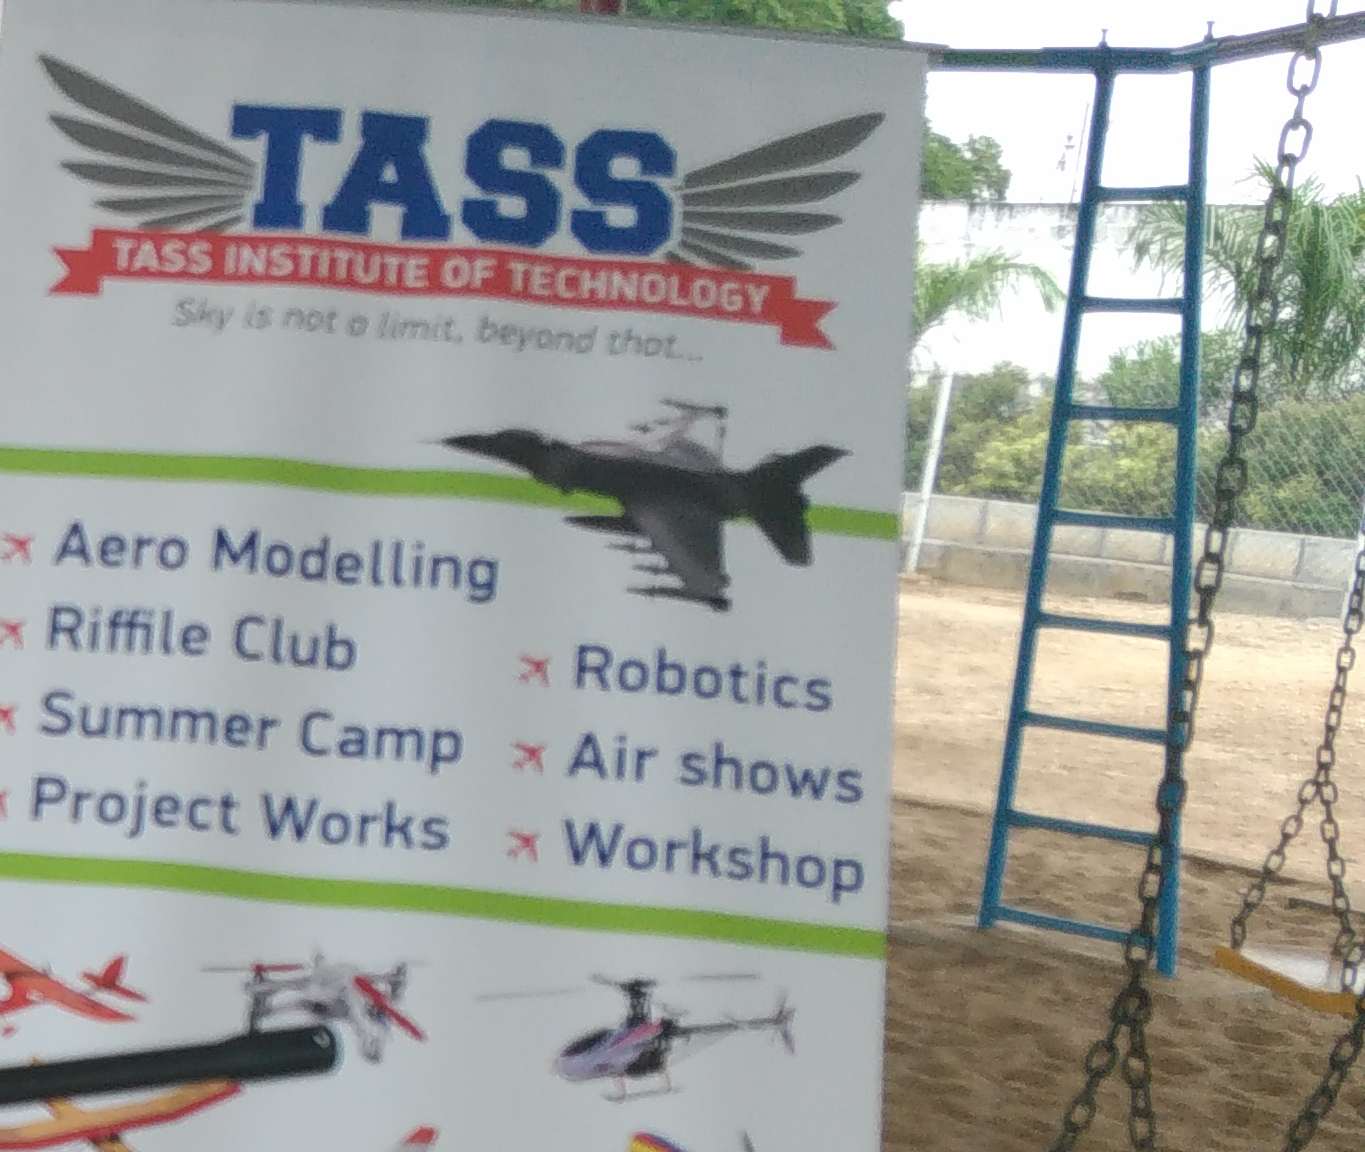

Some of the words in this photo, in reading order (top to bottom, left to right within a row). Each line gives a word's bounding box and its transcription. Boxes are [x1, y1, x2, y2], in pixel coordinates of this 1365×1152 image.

[231, 104, 678, 257] TASS
[112, 236, 213, 275] TASS
[224, 243, 429, 288] INSTITUTE
[441, 255, 497, 289] OF
[508, 261, 770, 314] TECHNOLOGY
[172, 296, 235, 334] Sky
[242, 300, 274, 330] is
[282, 304, 339, 334] not
[346, 312, 368, 337] a
[475, 315, 598, 353] beyond
[54, 520, 189, 571] Aero
[212, 525, 501, 604] Modelling
[45, 604, 211, 660] Riffile
[233, 615, 358, 672] Club
[573, 644, 833, 714] Robotics
[38, 691, 278, 753] Summer
[298, 710, 464, 776] Camp
[566, 731, 658, 784] Air
[679, 740, 866, 805] shows
[30, 774, 241, 842] Project
[262, 790, 451, 853] Works
[561, 819, 866, 904] Workshop
